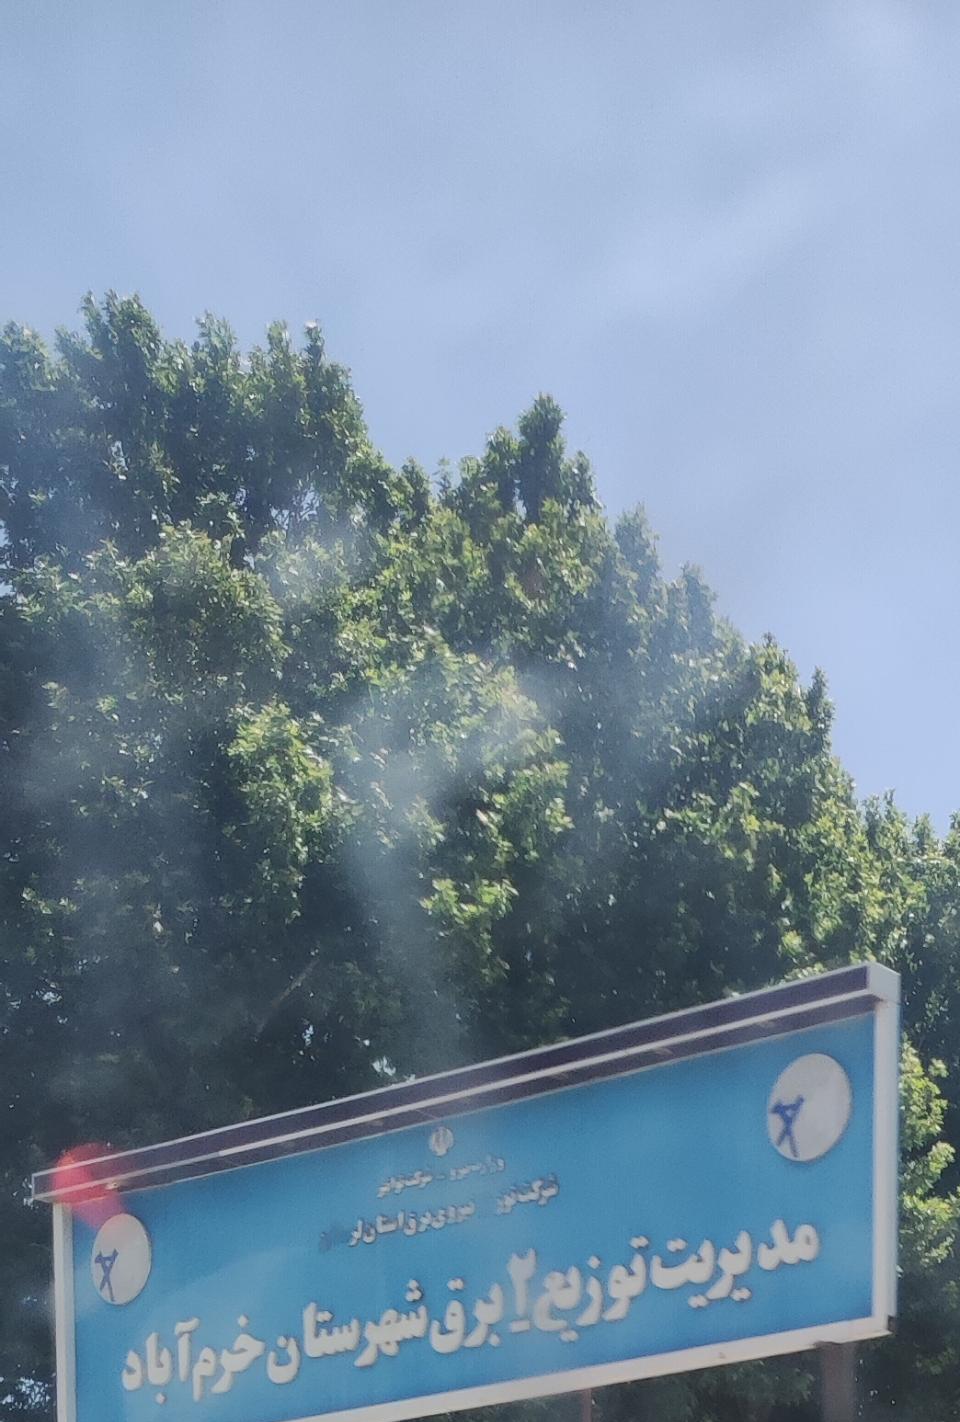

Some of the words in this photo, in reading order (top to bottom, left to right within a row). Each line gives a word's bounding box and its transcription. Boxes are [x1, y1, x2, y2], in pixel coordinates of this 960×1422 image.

[532, 1235, 651, 1344] توزیع
[650, 1217, 821, 1309] مدیریت
[265, 1278, 430, 1385] شهرستان
[429, 1277, 504, 1355] برق
